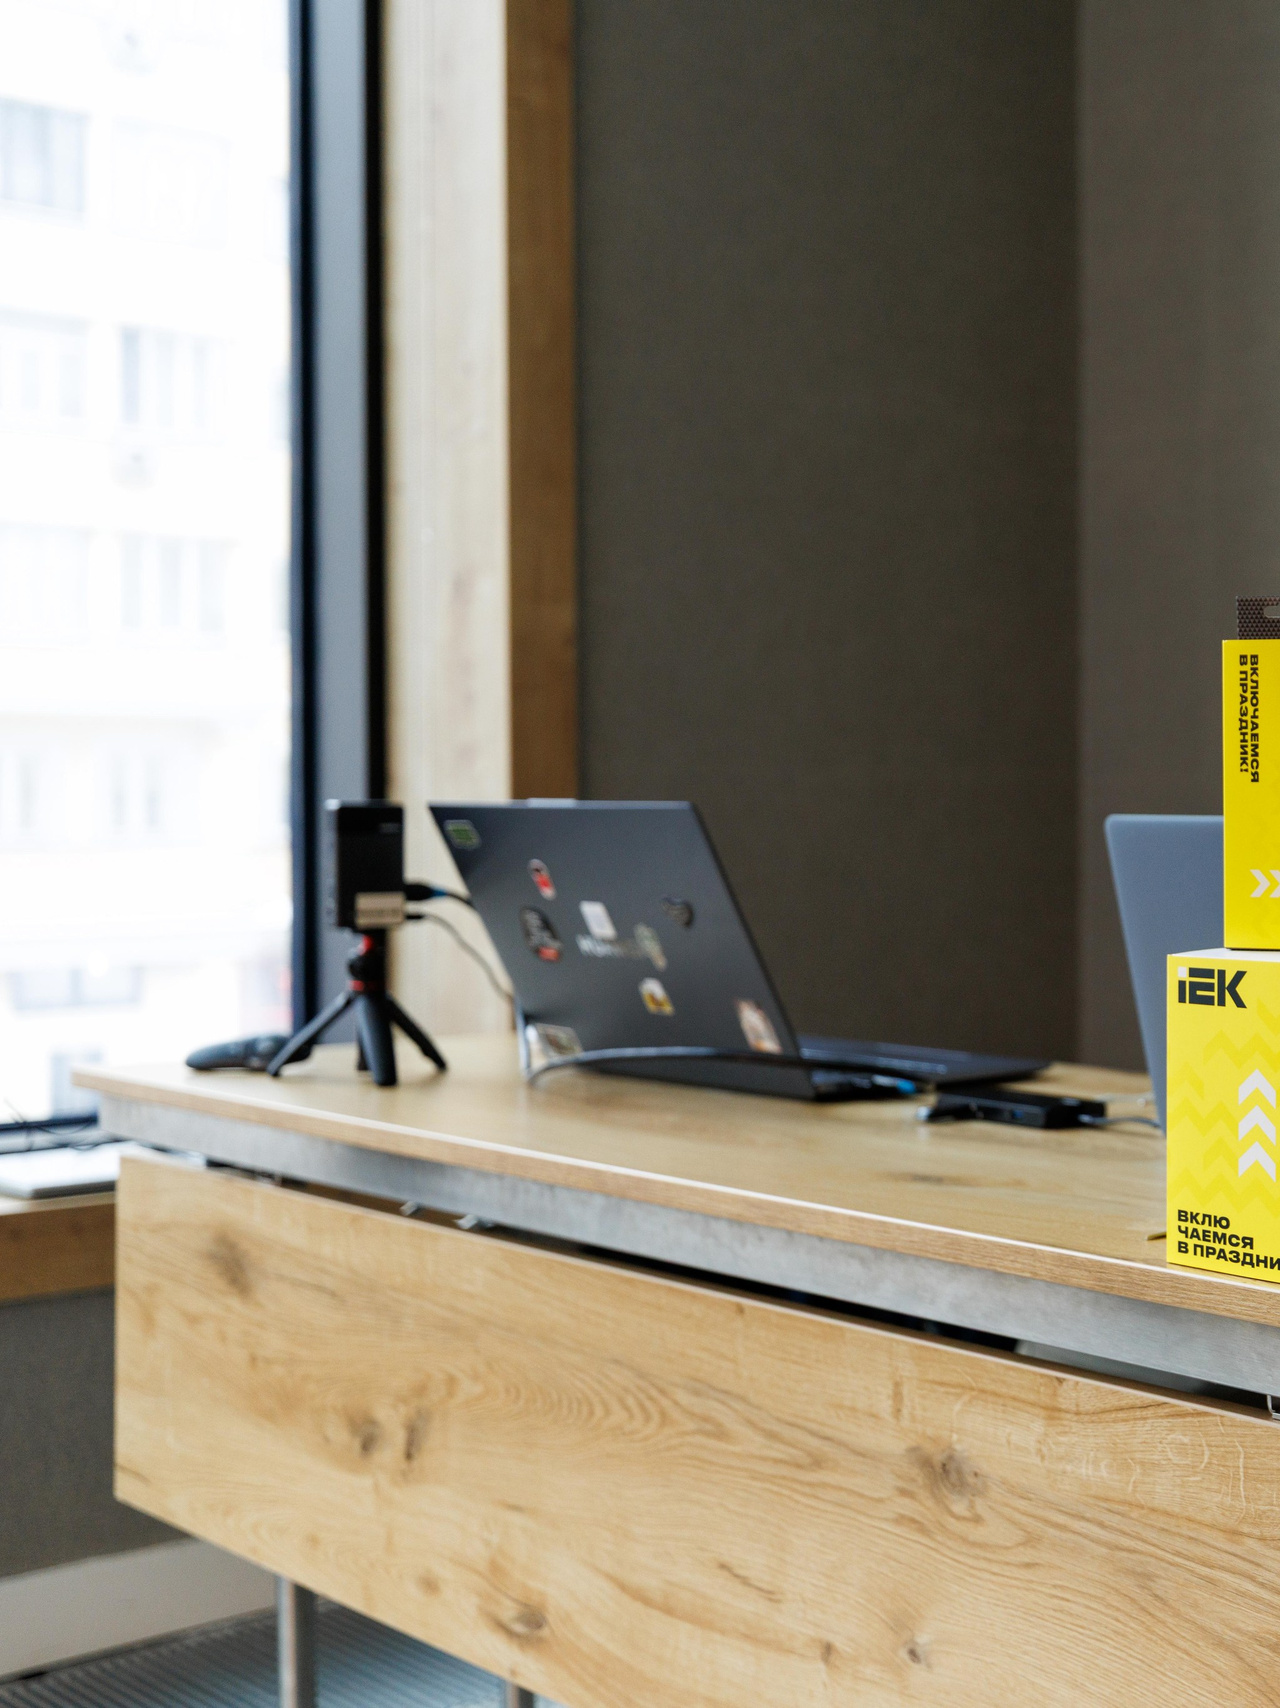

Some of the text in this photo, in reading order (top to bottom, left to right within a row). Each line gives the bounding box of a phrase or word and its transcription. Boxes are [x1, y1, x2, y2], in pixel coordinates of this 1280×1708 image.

[1238, 654, 1249, 773] В ПРАЗДНИК!
[1250, 654, 1259, 782] ВКЛЮЧАЕМСЯ
[1178, 1209, 1230, 1229] ВКЛЮ
[1178, 1225, 1254, 1250] ЧАЕМСЯ
[1178, 1241, 1189, 1254] В
